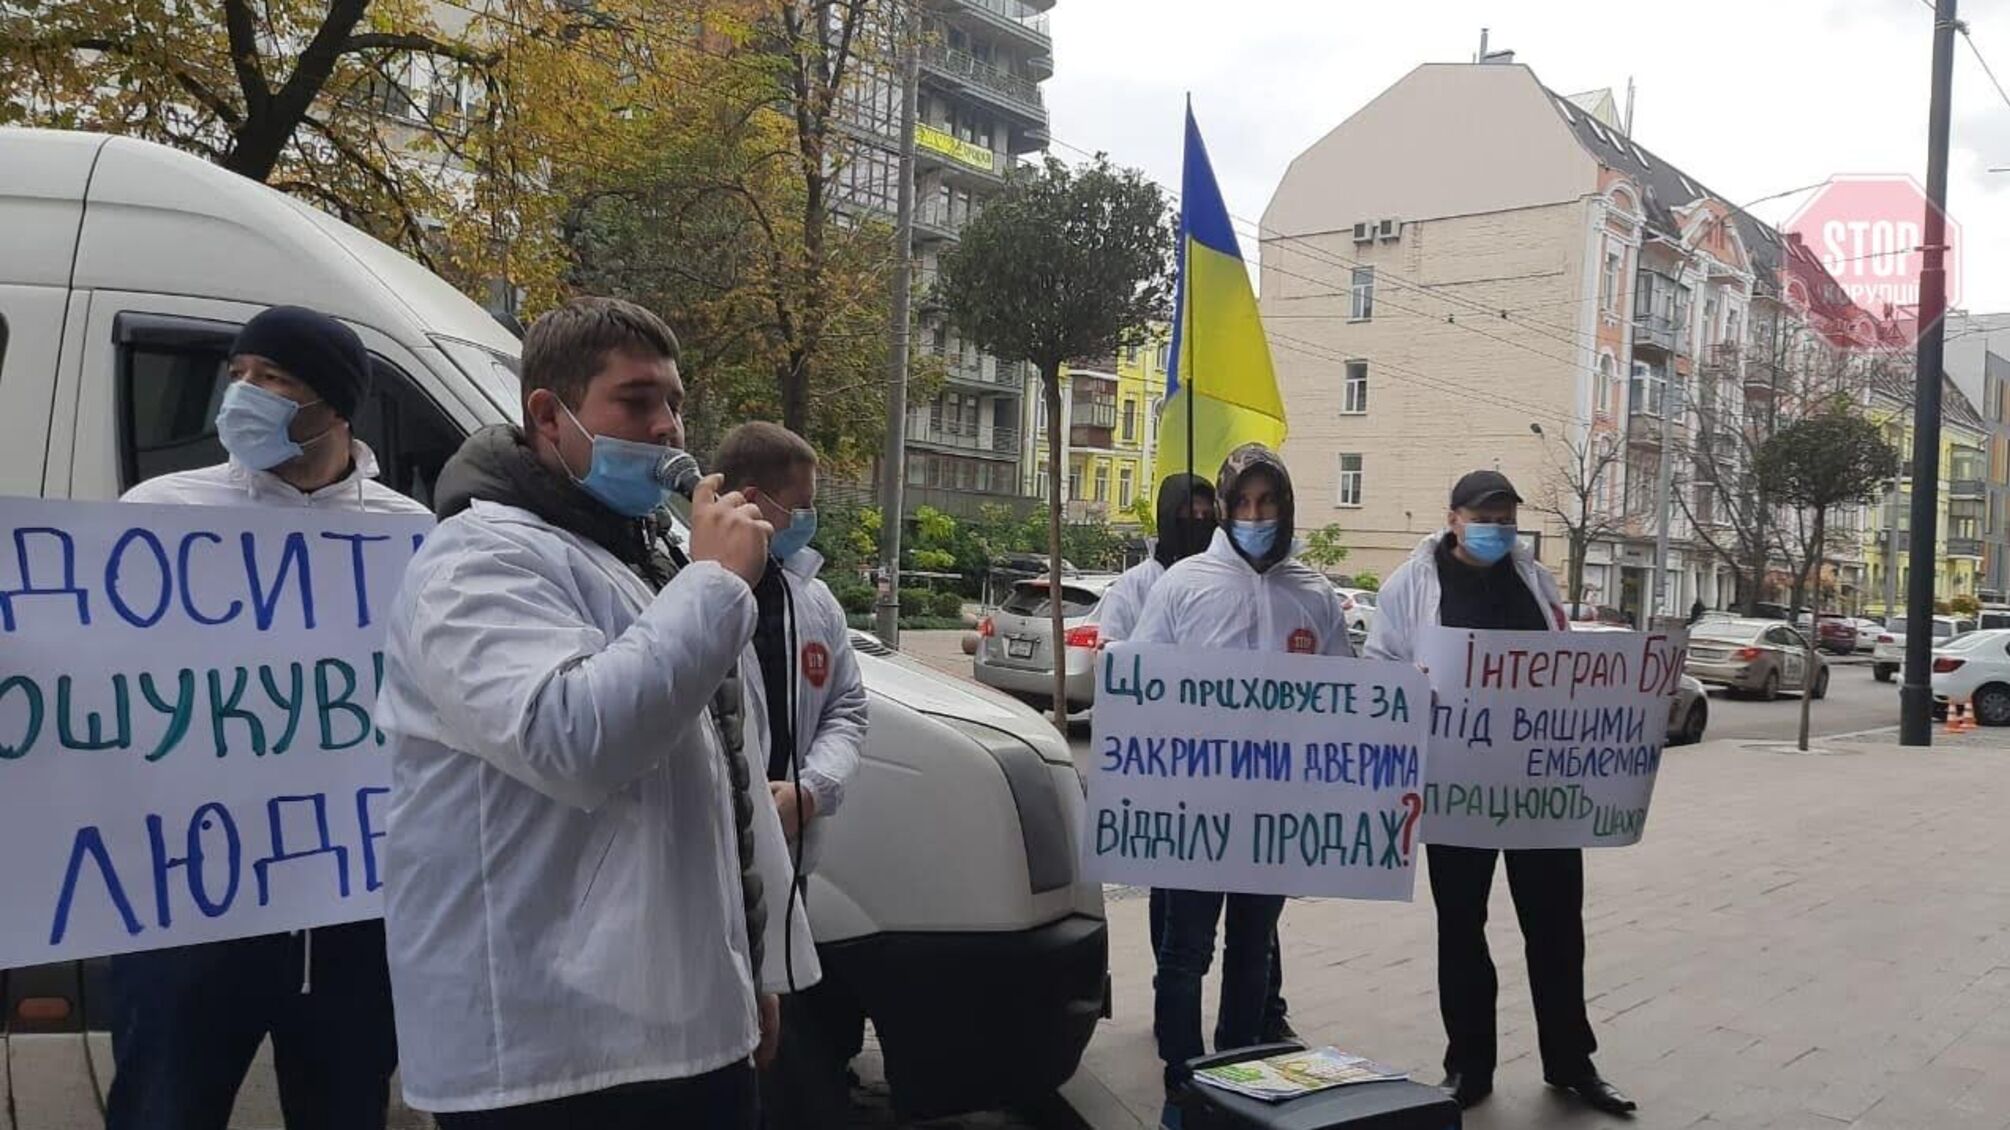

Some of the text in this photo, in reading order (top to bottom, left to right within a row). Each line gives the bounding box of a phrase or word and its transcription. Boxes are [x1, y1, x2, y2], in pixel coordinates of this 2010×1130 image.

[0, 528, 423, 631] ДОСИТ
[1104, 652, 1165, 705] Що
[1370, 685, 1408, 723] ЗА
[1512, 706, 1646, 743] ВАШИМИ
[1100, 735, 1419, 791] ЗАКРИТИМИ ДВЕРИМА
[1423, 782, 1594, 827] ПРАЦЮЮТЬ
